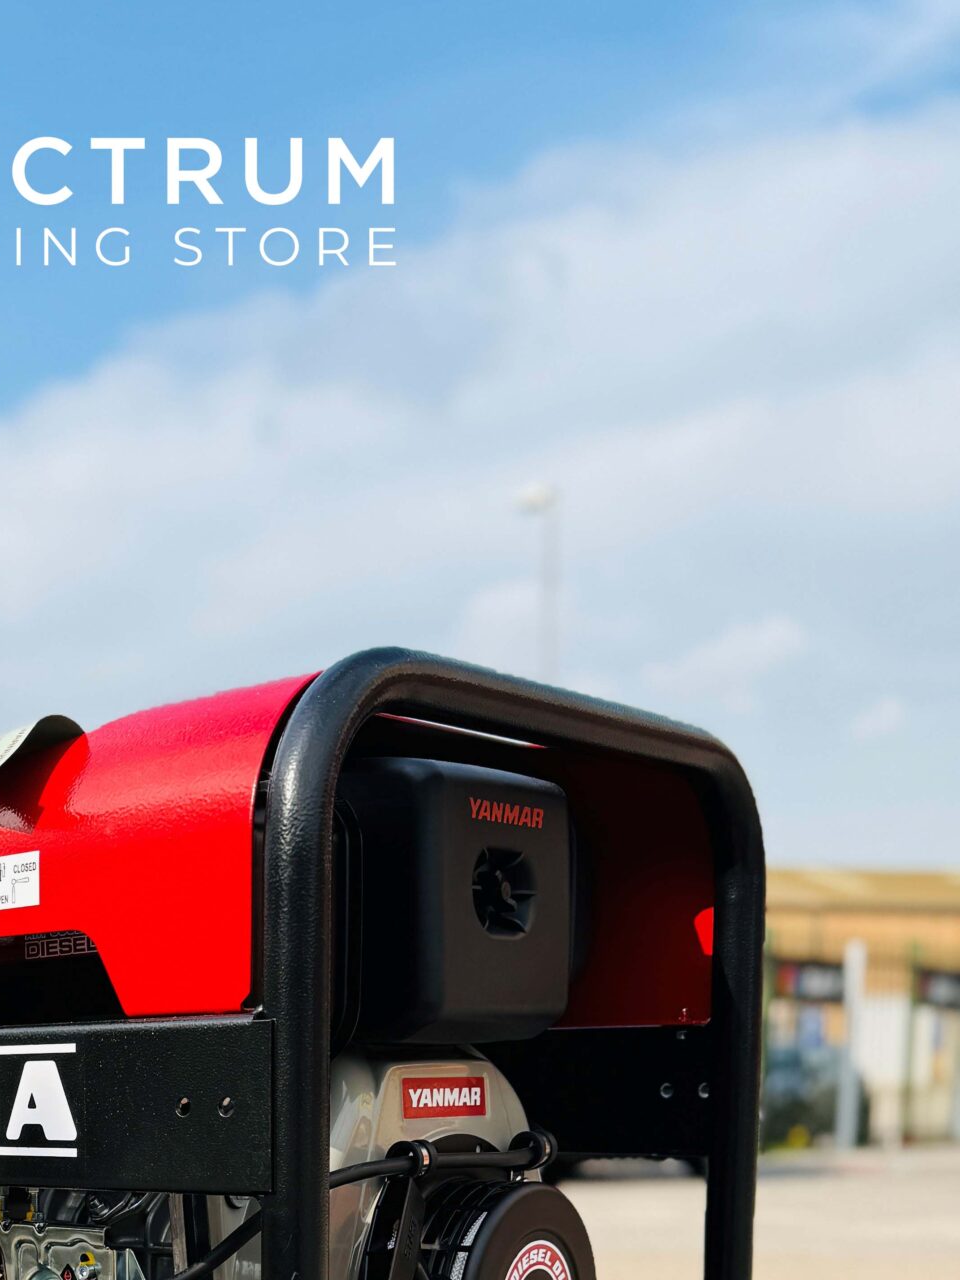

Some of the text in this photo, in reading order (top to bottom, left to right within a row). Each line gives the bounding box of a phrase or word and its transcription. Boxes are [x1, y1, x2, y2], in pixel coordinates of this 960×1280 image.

[469, 797, 544, 829] YANMAR
[13, 861, 37, 874] CLOSED
[25, 936, 98, 960] DIESEL
[408, 1087, 481, 1108] YANMAR
